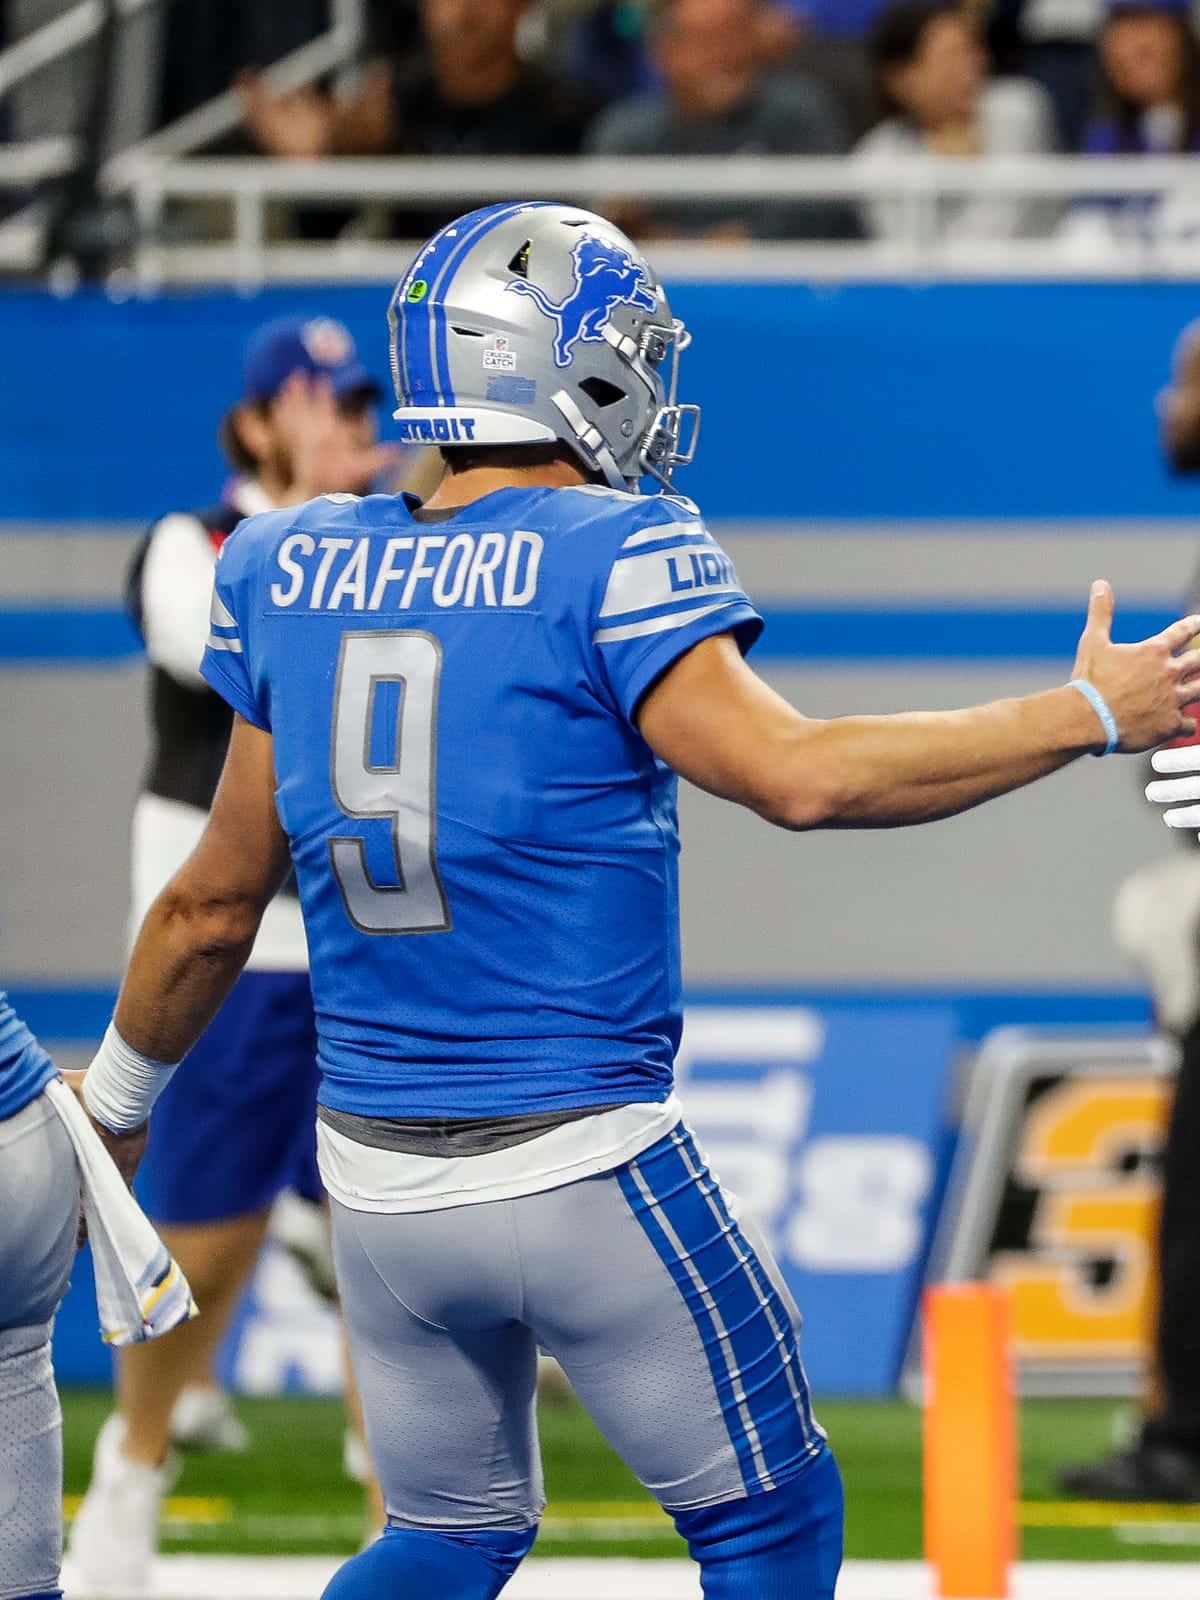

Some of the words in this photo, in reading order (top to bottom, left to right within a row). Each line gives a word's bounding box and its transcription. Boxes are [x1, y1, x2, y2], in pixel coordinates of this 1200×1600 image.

[485, 358, 513, 368] CATCH
[400, 418, 475, 440] ETROIT
[270, 531, 544, 611] STAFFORD
[665, 552, 737, 592] LION
[328, 630, 452, 936] 9
